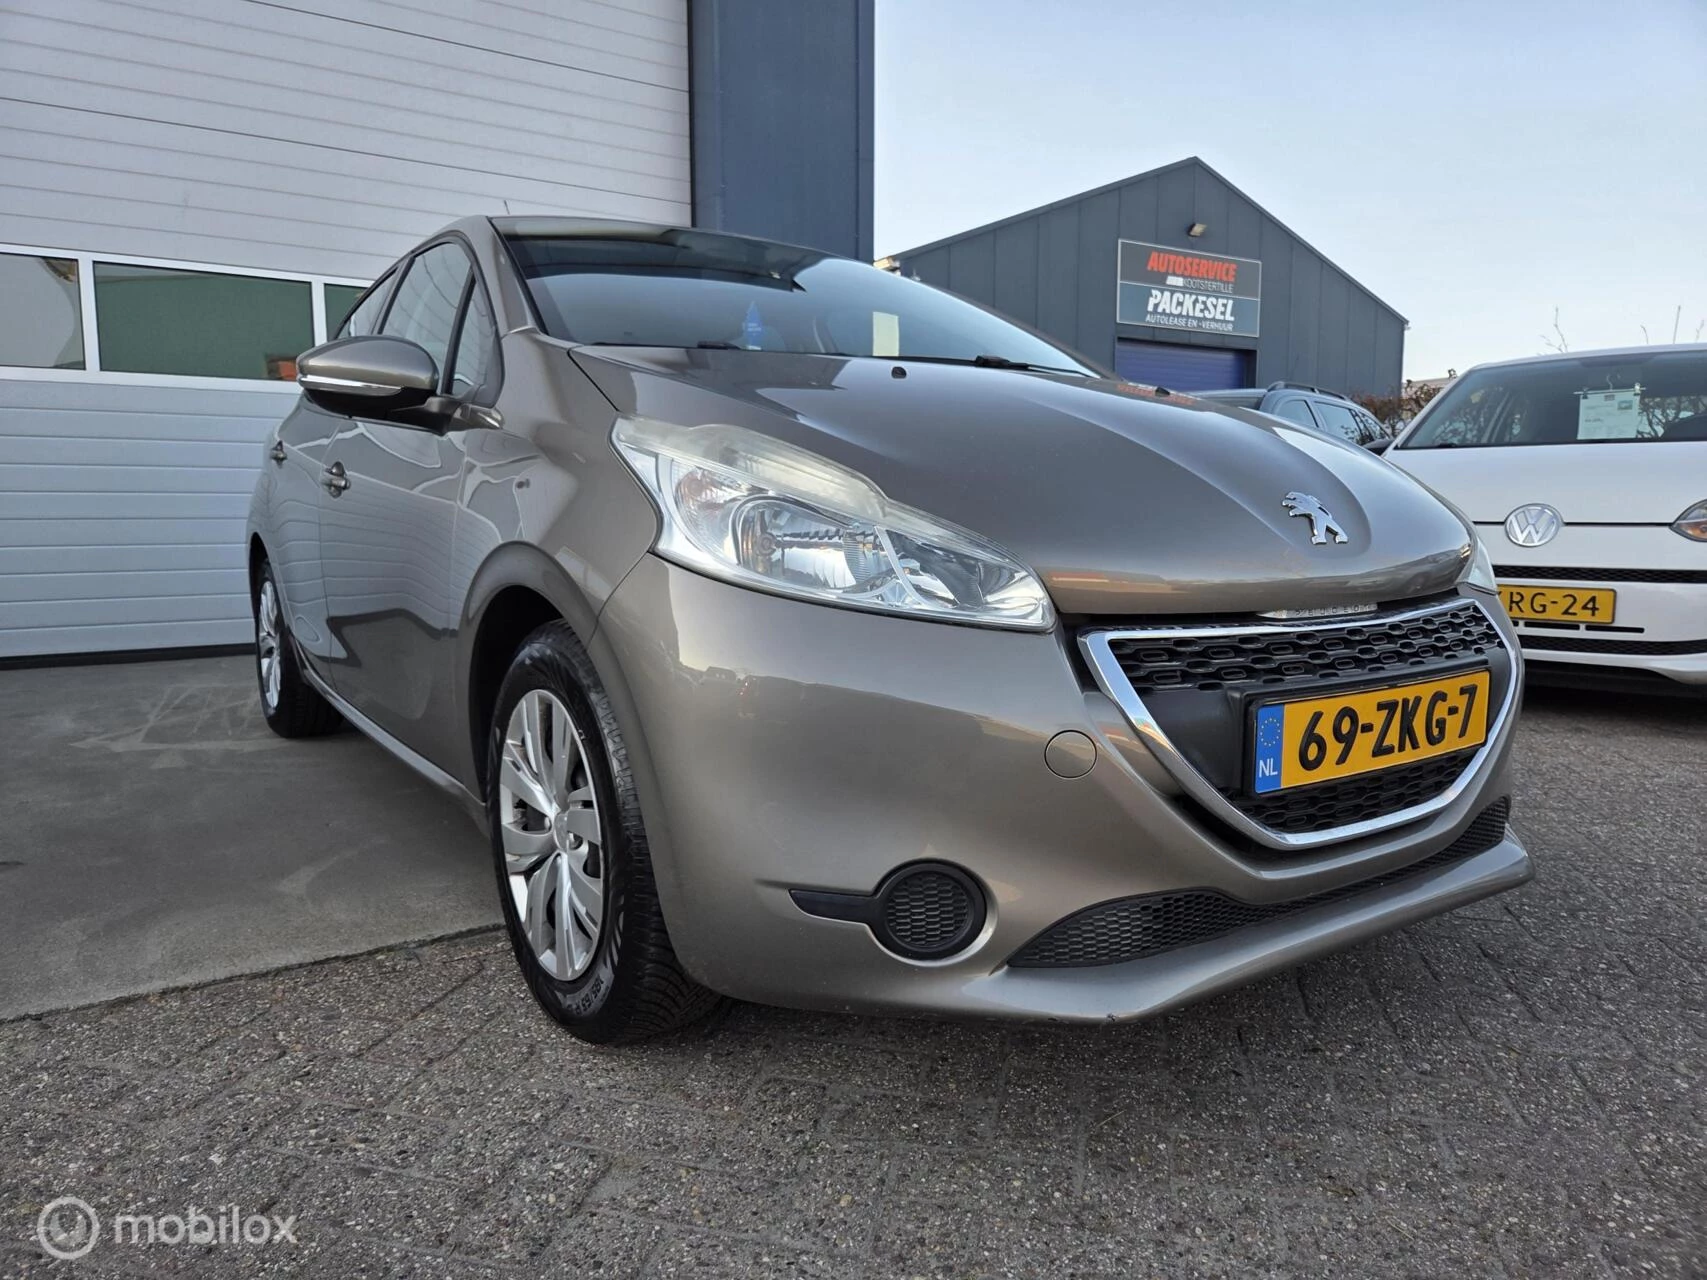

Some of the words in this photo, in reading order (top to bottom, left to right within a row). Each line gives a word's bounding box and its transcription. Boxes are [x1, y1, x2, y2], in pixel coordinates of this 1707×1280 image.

[1147, 251, 1236, 281] AUTOSERVICE
[1147, 289, 1235, 321] PACKESEL
[1145, 314, 1188, 327] AUTOLEASE
[1188, 318, 1198, 328] EN
[1498, 591, 1600, 617] RG-24
[1298, 684, 1478, 771] 69-ZKG-7
[1259, 758, 1278, 778] NL
